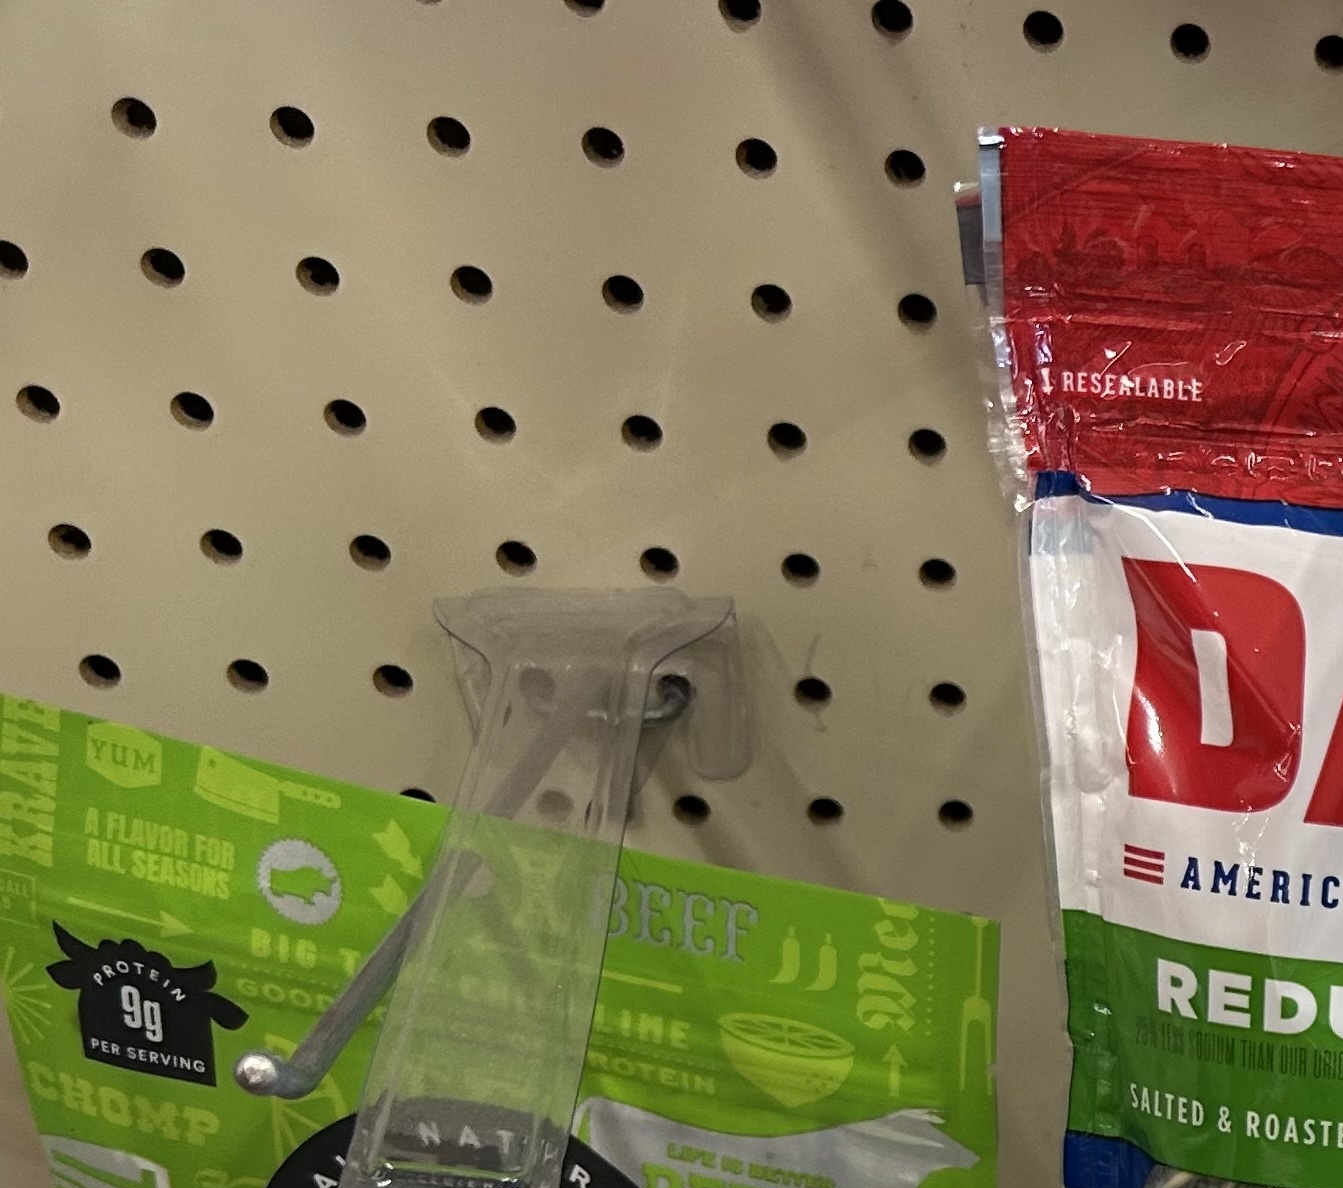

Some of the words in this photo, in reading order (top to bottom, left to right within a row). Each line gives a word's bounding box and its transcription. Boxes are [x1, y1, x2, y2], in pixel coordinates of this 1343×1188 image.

[1062, 370, 1203, 402] RESEALABLE
[90, 738, 157, 773] YUM
[84, 807, 99, 836] A
[106, 812, 190, 857] FLAVOR
[195, 834, 237, 871] FOR
[87, 838, 127, 875] ALL
[131, 852, 231, 900] SEASONS
[590, 872, 760, 962] BEEF
[93, 959, 187, 1003] PROTEIN
[120, 984, 164, 1043] 9g
[90, 1036, 121, 1057] PER
[126, 1045, 207, 1075] SERVING
[28, 1060, 220, 1145] CHOMP
[1128, 1083, 1204, 1127] SALTED
[1217, 1107, 1231, 1134] &
